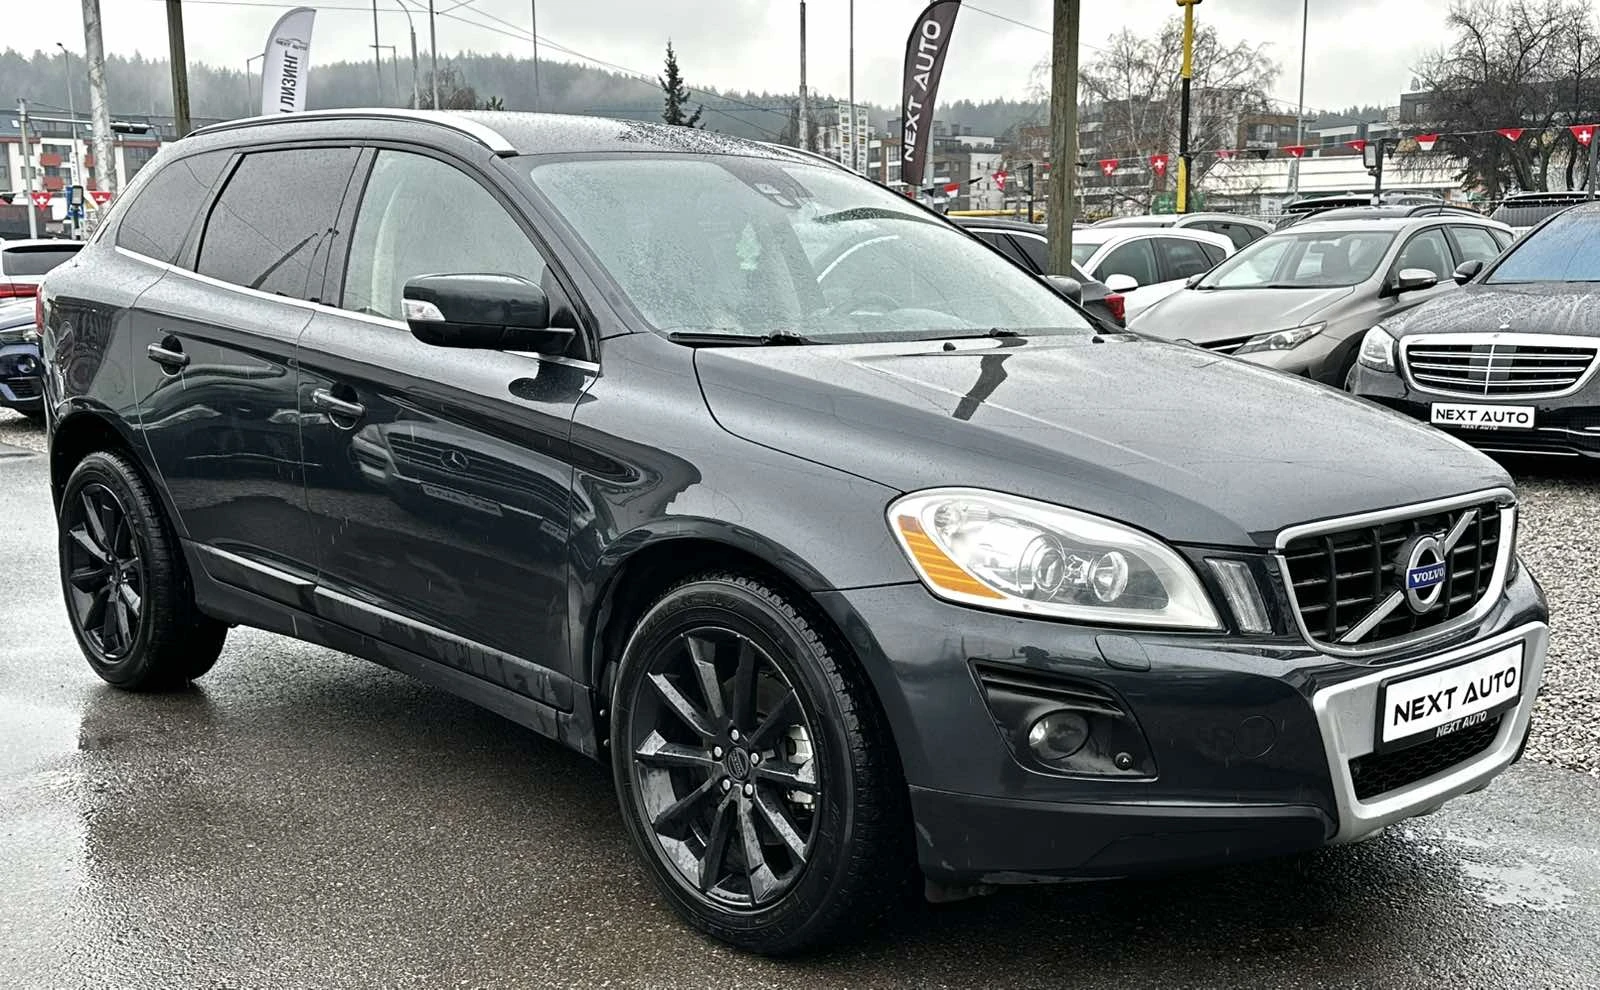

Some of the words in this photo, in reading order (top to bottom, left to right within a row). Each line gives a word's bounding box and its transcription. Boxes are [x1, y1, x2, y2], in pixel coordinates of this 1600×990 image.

[280, 50, 298, 107] ЛИЗИНГ
[903, 95, 922, 162] NEXT
[913, 19, 942, 91] AUTO
[1436, 408, 1477, 421] NEXT
[1480, 411, 1529, 424] AUTO
[1412, 567, 1444, 583] VOLVO
[1393, 686, 1458, 726] NEXT
[1462, 667, 1516, 705] AUTO
[1436, 719, 1461, 738] NEXT
[1462, 711, 1487, 728] AUTO
